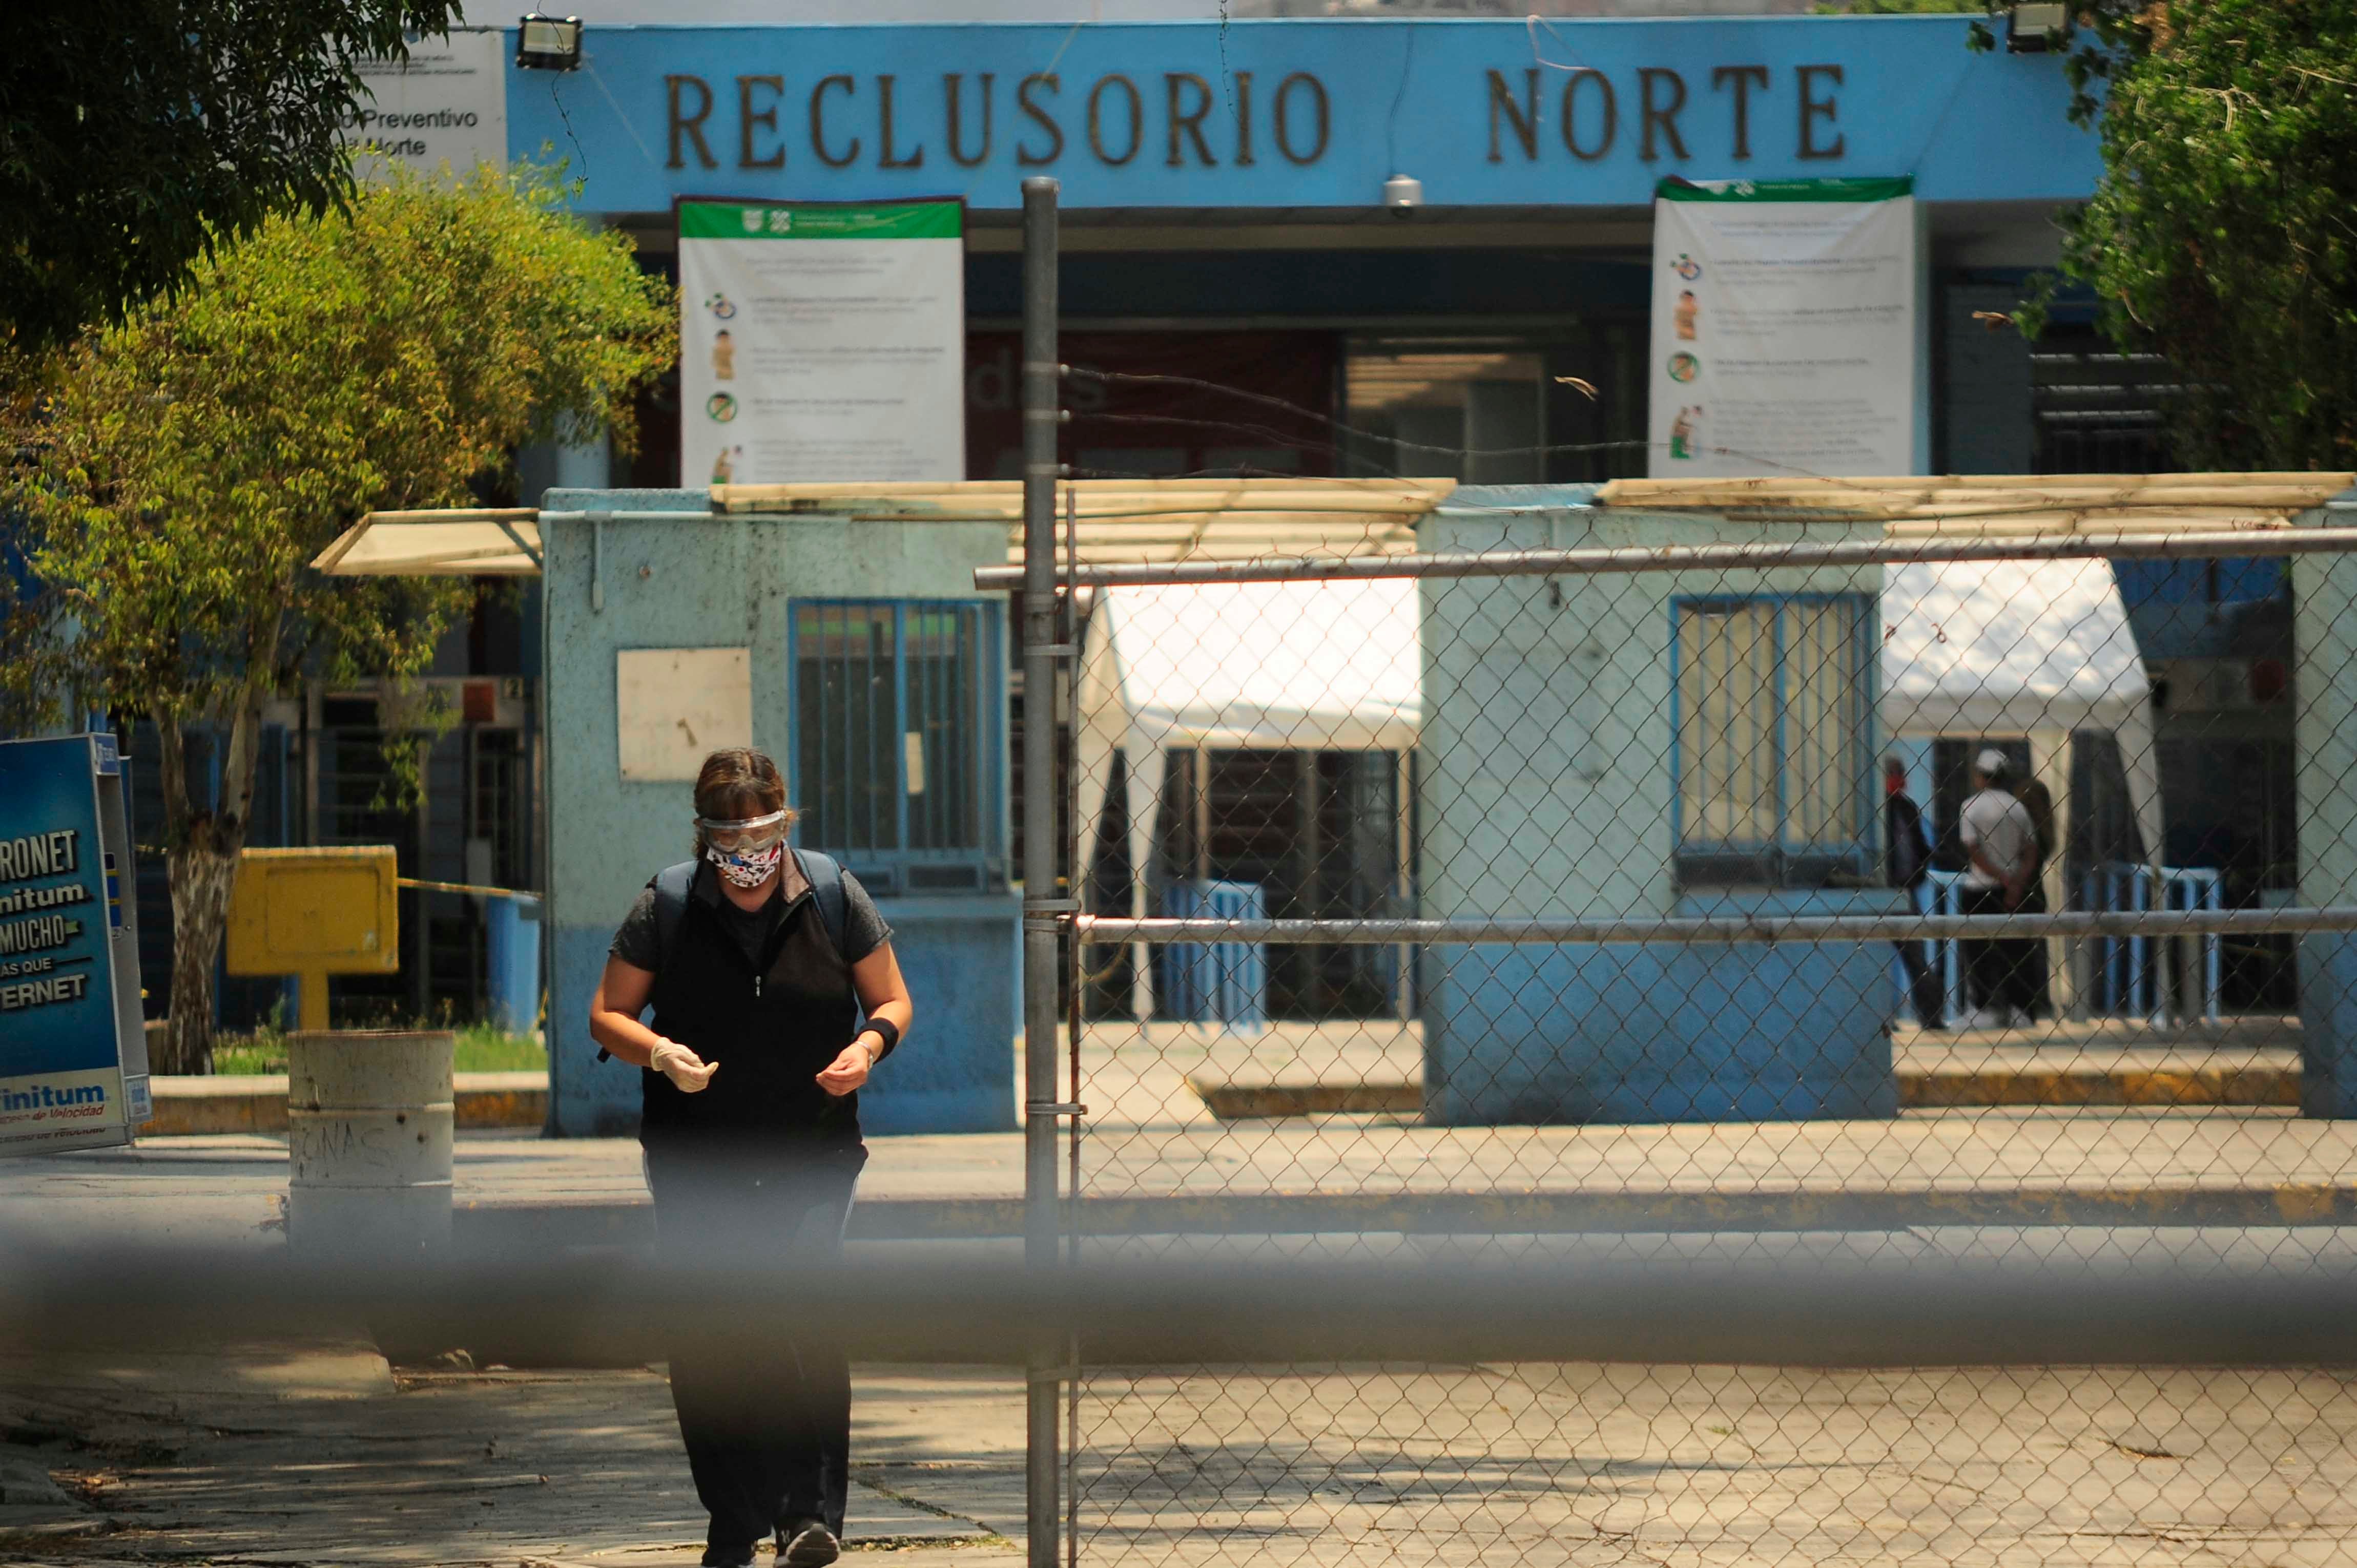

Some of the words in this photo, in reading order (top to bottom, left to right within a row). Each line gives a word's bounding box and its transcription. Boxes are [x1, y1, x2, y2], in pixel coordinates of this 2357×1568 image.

[361, 108, 478, 128] Preventivo
[663, 72, 1330, 170] RECLUSORIO
[1486, 64, 1844, 163] NORTE
[0, 914, 65, 953] MUCHO
[22, 957, 52, 973] QUE
[0, 974, 86, 1009] ERNET
[0, 1084, 105, 1111] initum
[50, 1104, 106, 1119] Velocidad
